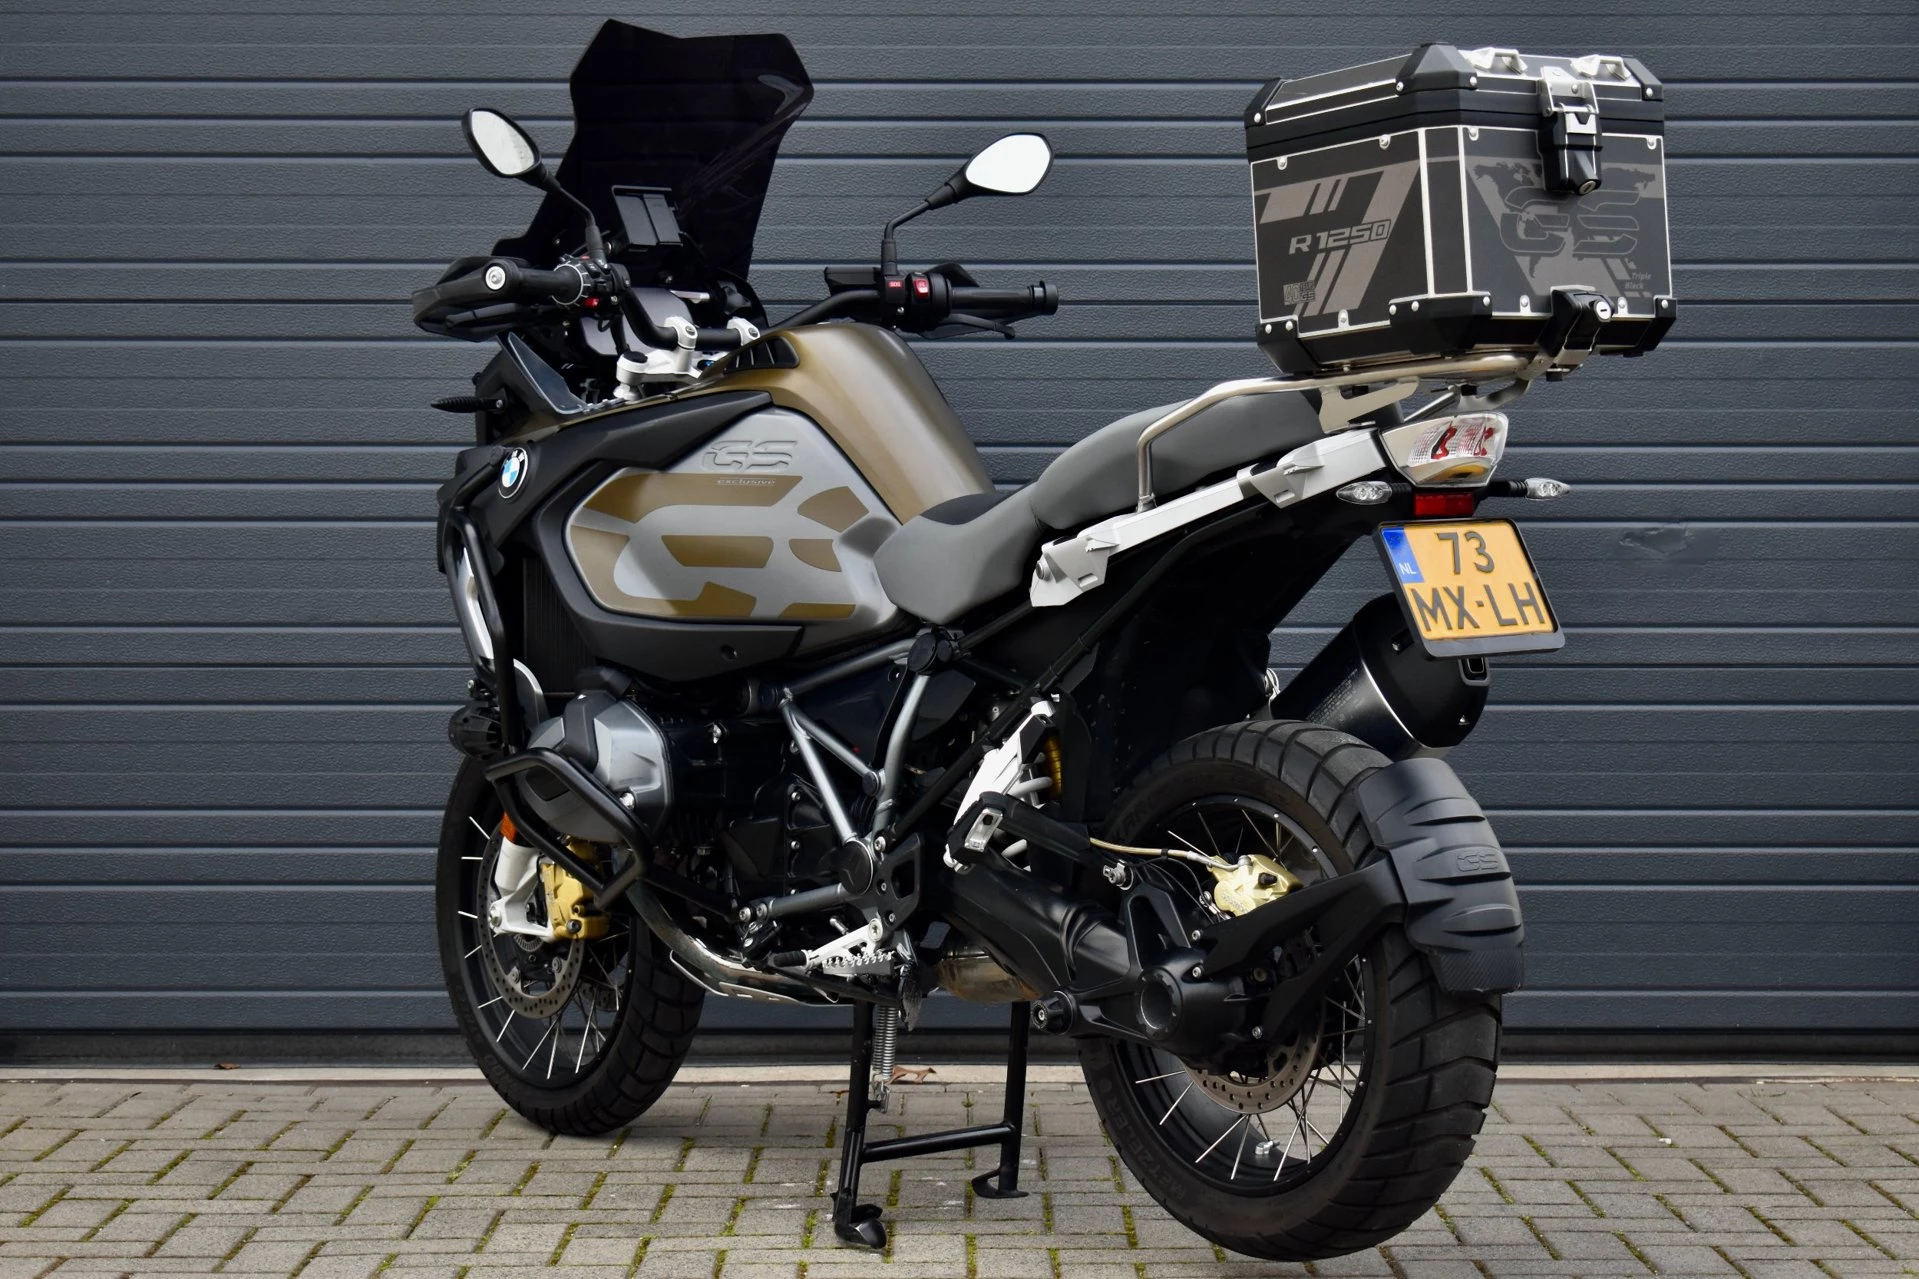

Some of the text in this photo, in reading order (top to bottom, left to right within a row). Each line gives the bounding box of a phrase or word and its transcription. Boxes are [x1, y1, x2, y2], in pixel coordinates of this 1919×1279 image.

[1500, 186, 1640, 255] GS
[1624, 281, 1645, 290] Black
[1631, 272, 1652, 282] Triple
[702, 440, 799, 472] GS
[1398, 562, 1417, 575] NL
[1436, 530, 1495, 575] 73
[1410, 581, 1546, 632] MX-LH
[1456, 853, 1499, 873] GS
[1106, 1098, 1188, 1201] METZELER
